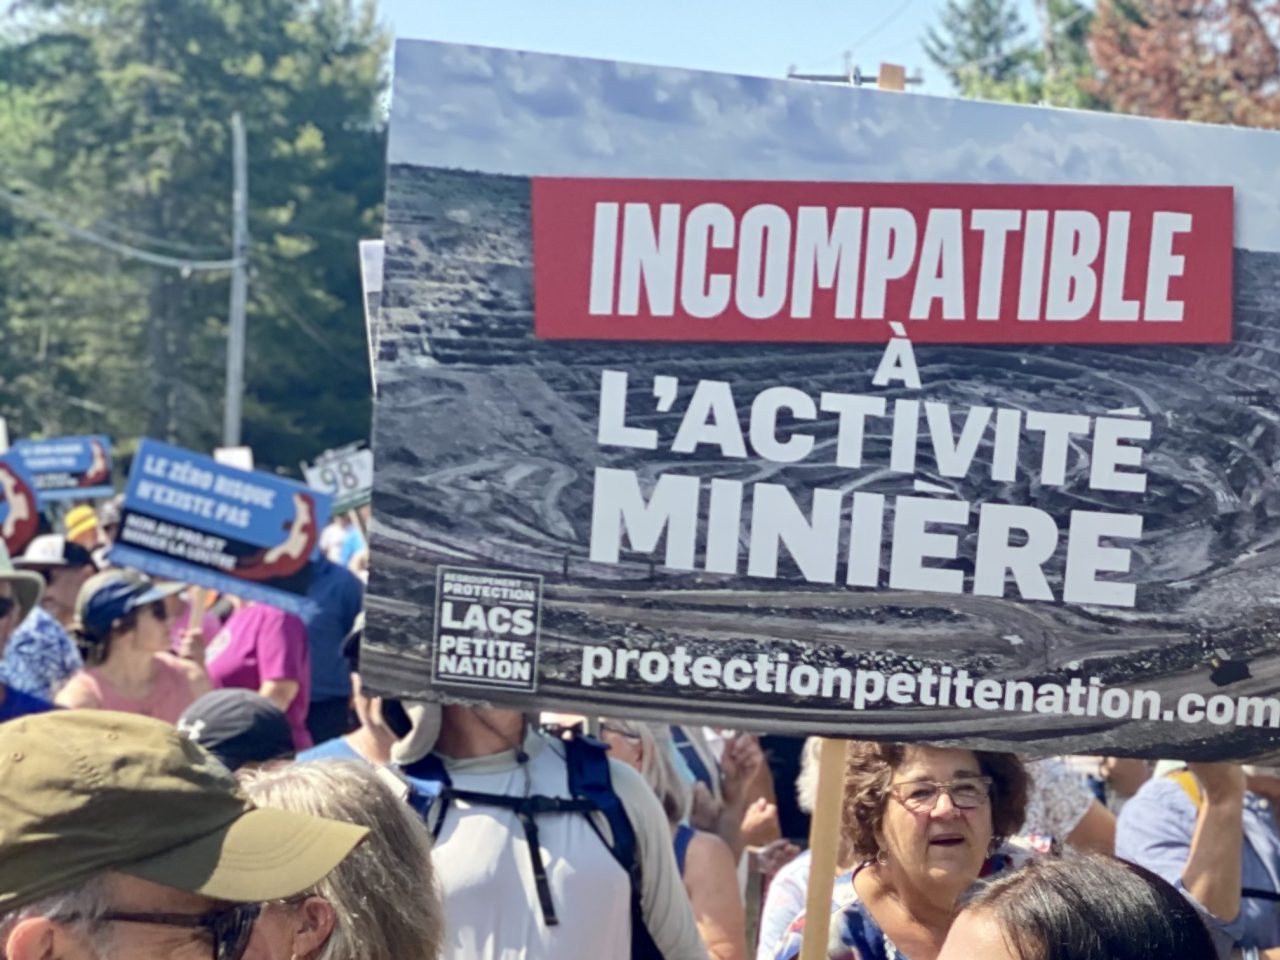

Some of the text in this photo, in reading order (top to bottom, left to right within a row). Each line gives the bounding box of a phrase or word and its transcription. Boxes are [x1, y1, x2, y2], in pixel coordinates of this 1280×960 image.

[588, 201, 1193, 323] INCOMPATIBLE
[872, 320, 920, 390] À
[598, 370, 1152, 493] L'ACTIVITÉ
[143, 454, 277, 510] LE ZÉRO RISQUE
[214, 501, 251, 529] PAS
[589, 467, 1144, 607] MINIÈRE
[443, 582, 535, 602] PROTECTION
[441, 601, 535, 636] LACS
[438, 654, 531, 680] NATION
[440, 635, 534, 660] PETITE-
